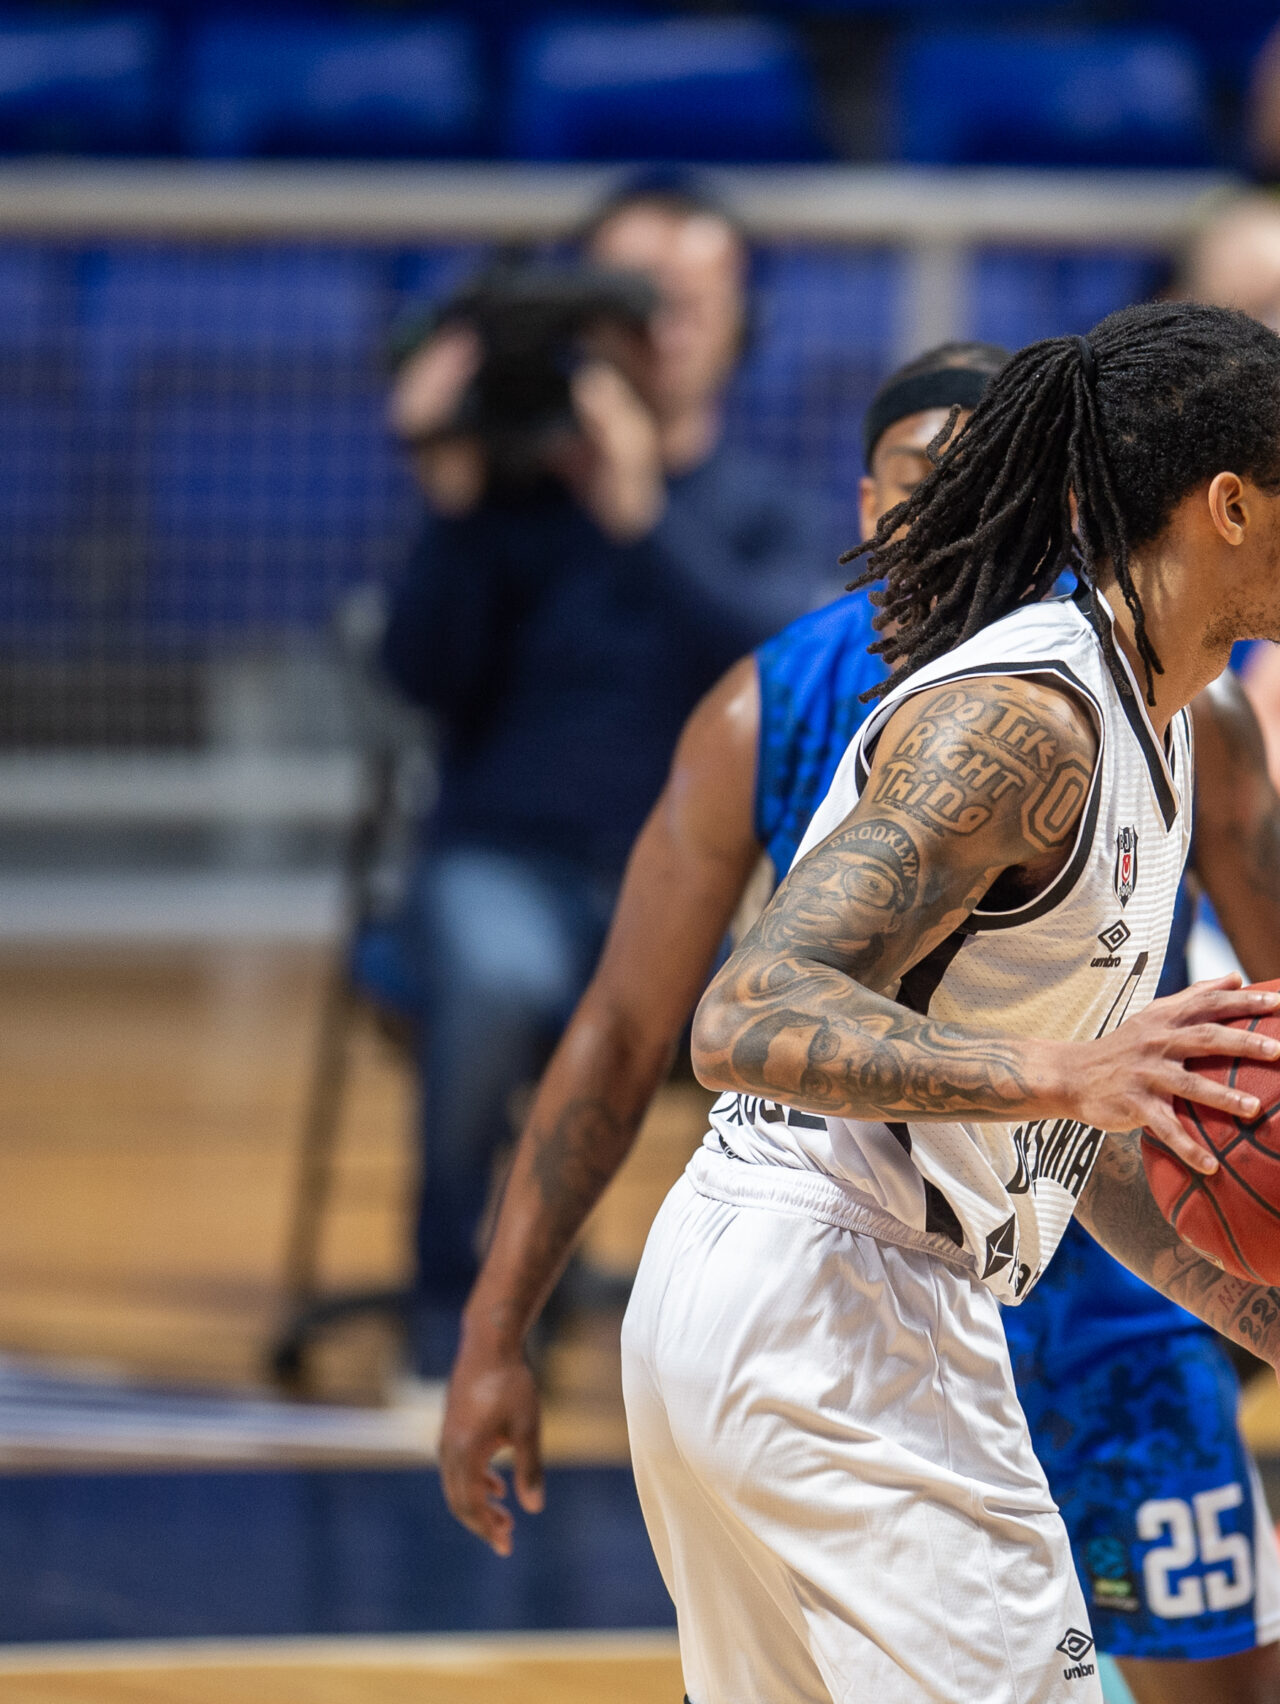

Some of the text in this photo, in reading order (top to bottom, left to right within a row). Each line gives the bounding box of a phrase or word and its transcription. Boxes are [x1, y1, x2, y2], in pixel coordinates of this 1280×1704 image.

[830, 824, 917, 878] BROOKLYN
[1090, 954, 1121, 968] umbro
[1135, 1481, 1253, 1619] 25
